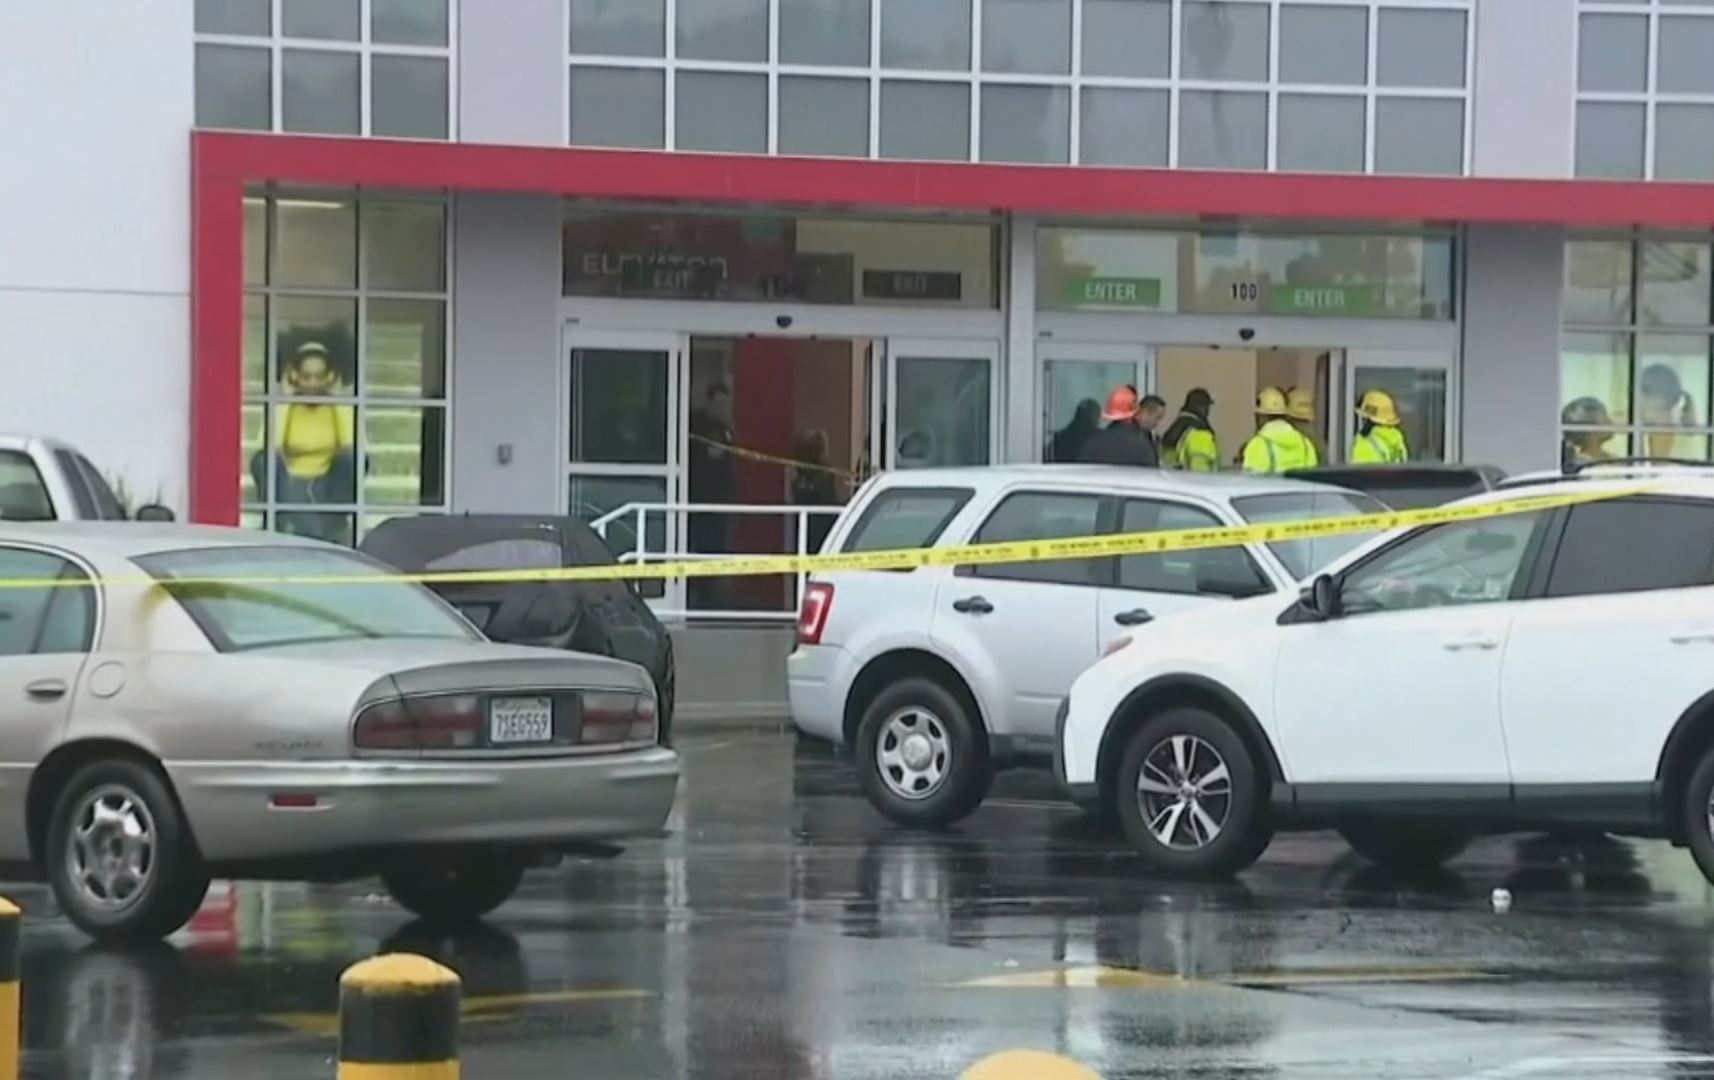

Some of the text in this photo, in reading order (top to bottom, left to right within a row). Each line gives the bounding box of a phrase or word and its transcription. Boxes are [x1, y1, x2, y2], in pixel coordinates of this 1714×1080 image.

[1084, 282, 1137, 301] ENTER
[1231, 282, 1258, 301] 100
[1294, 288, 1346, 308] ENTER
